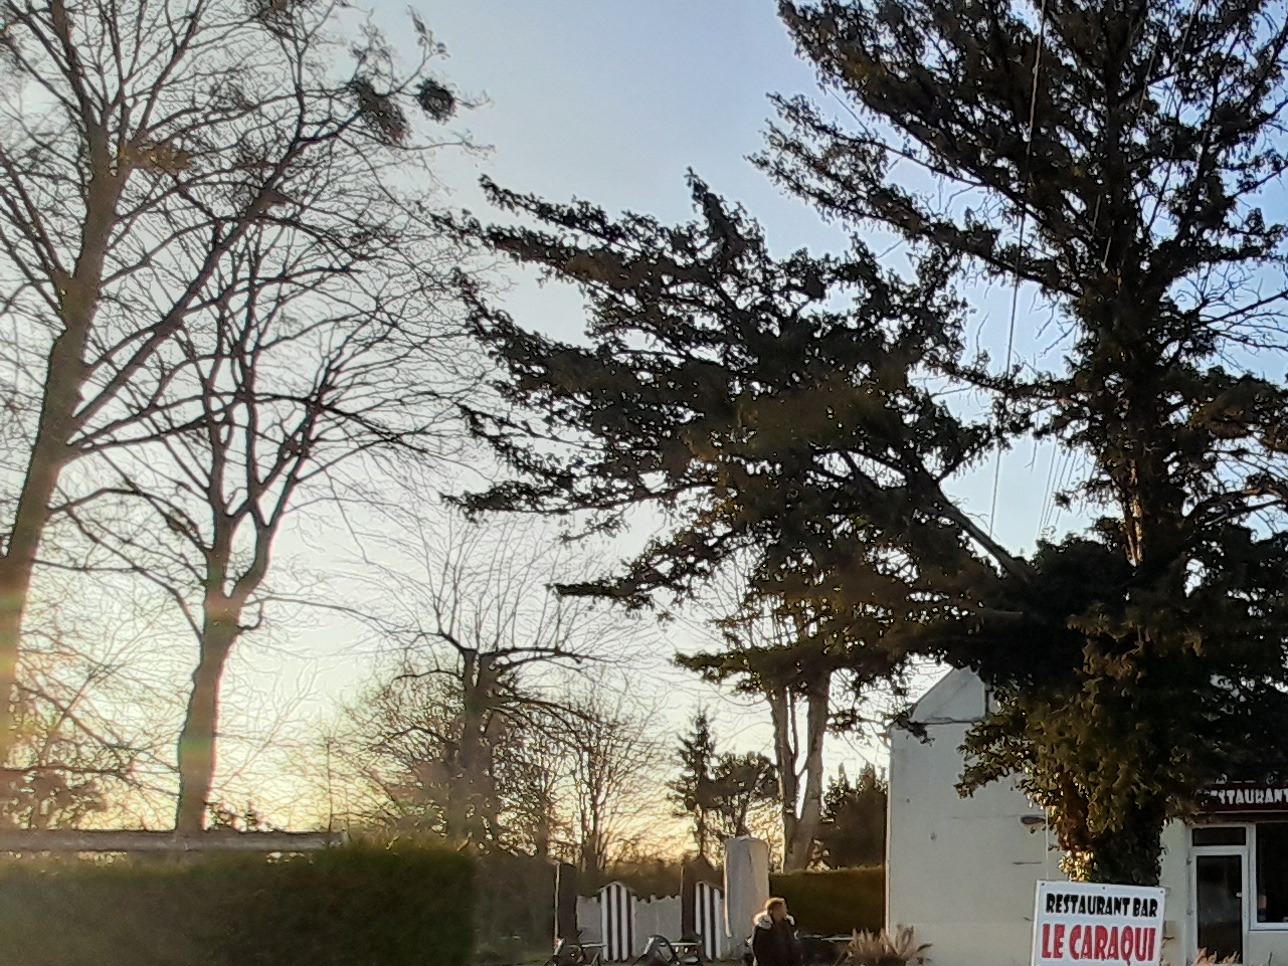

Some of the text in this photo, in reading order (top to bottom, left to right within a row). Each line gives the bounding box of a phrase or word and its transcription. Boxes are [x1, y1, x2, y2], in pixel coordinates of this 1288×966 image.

[1045, 893, 1158, 917] RESTAURANT BAR
[1041, 923, 1156, 966] LE CARAQUI
